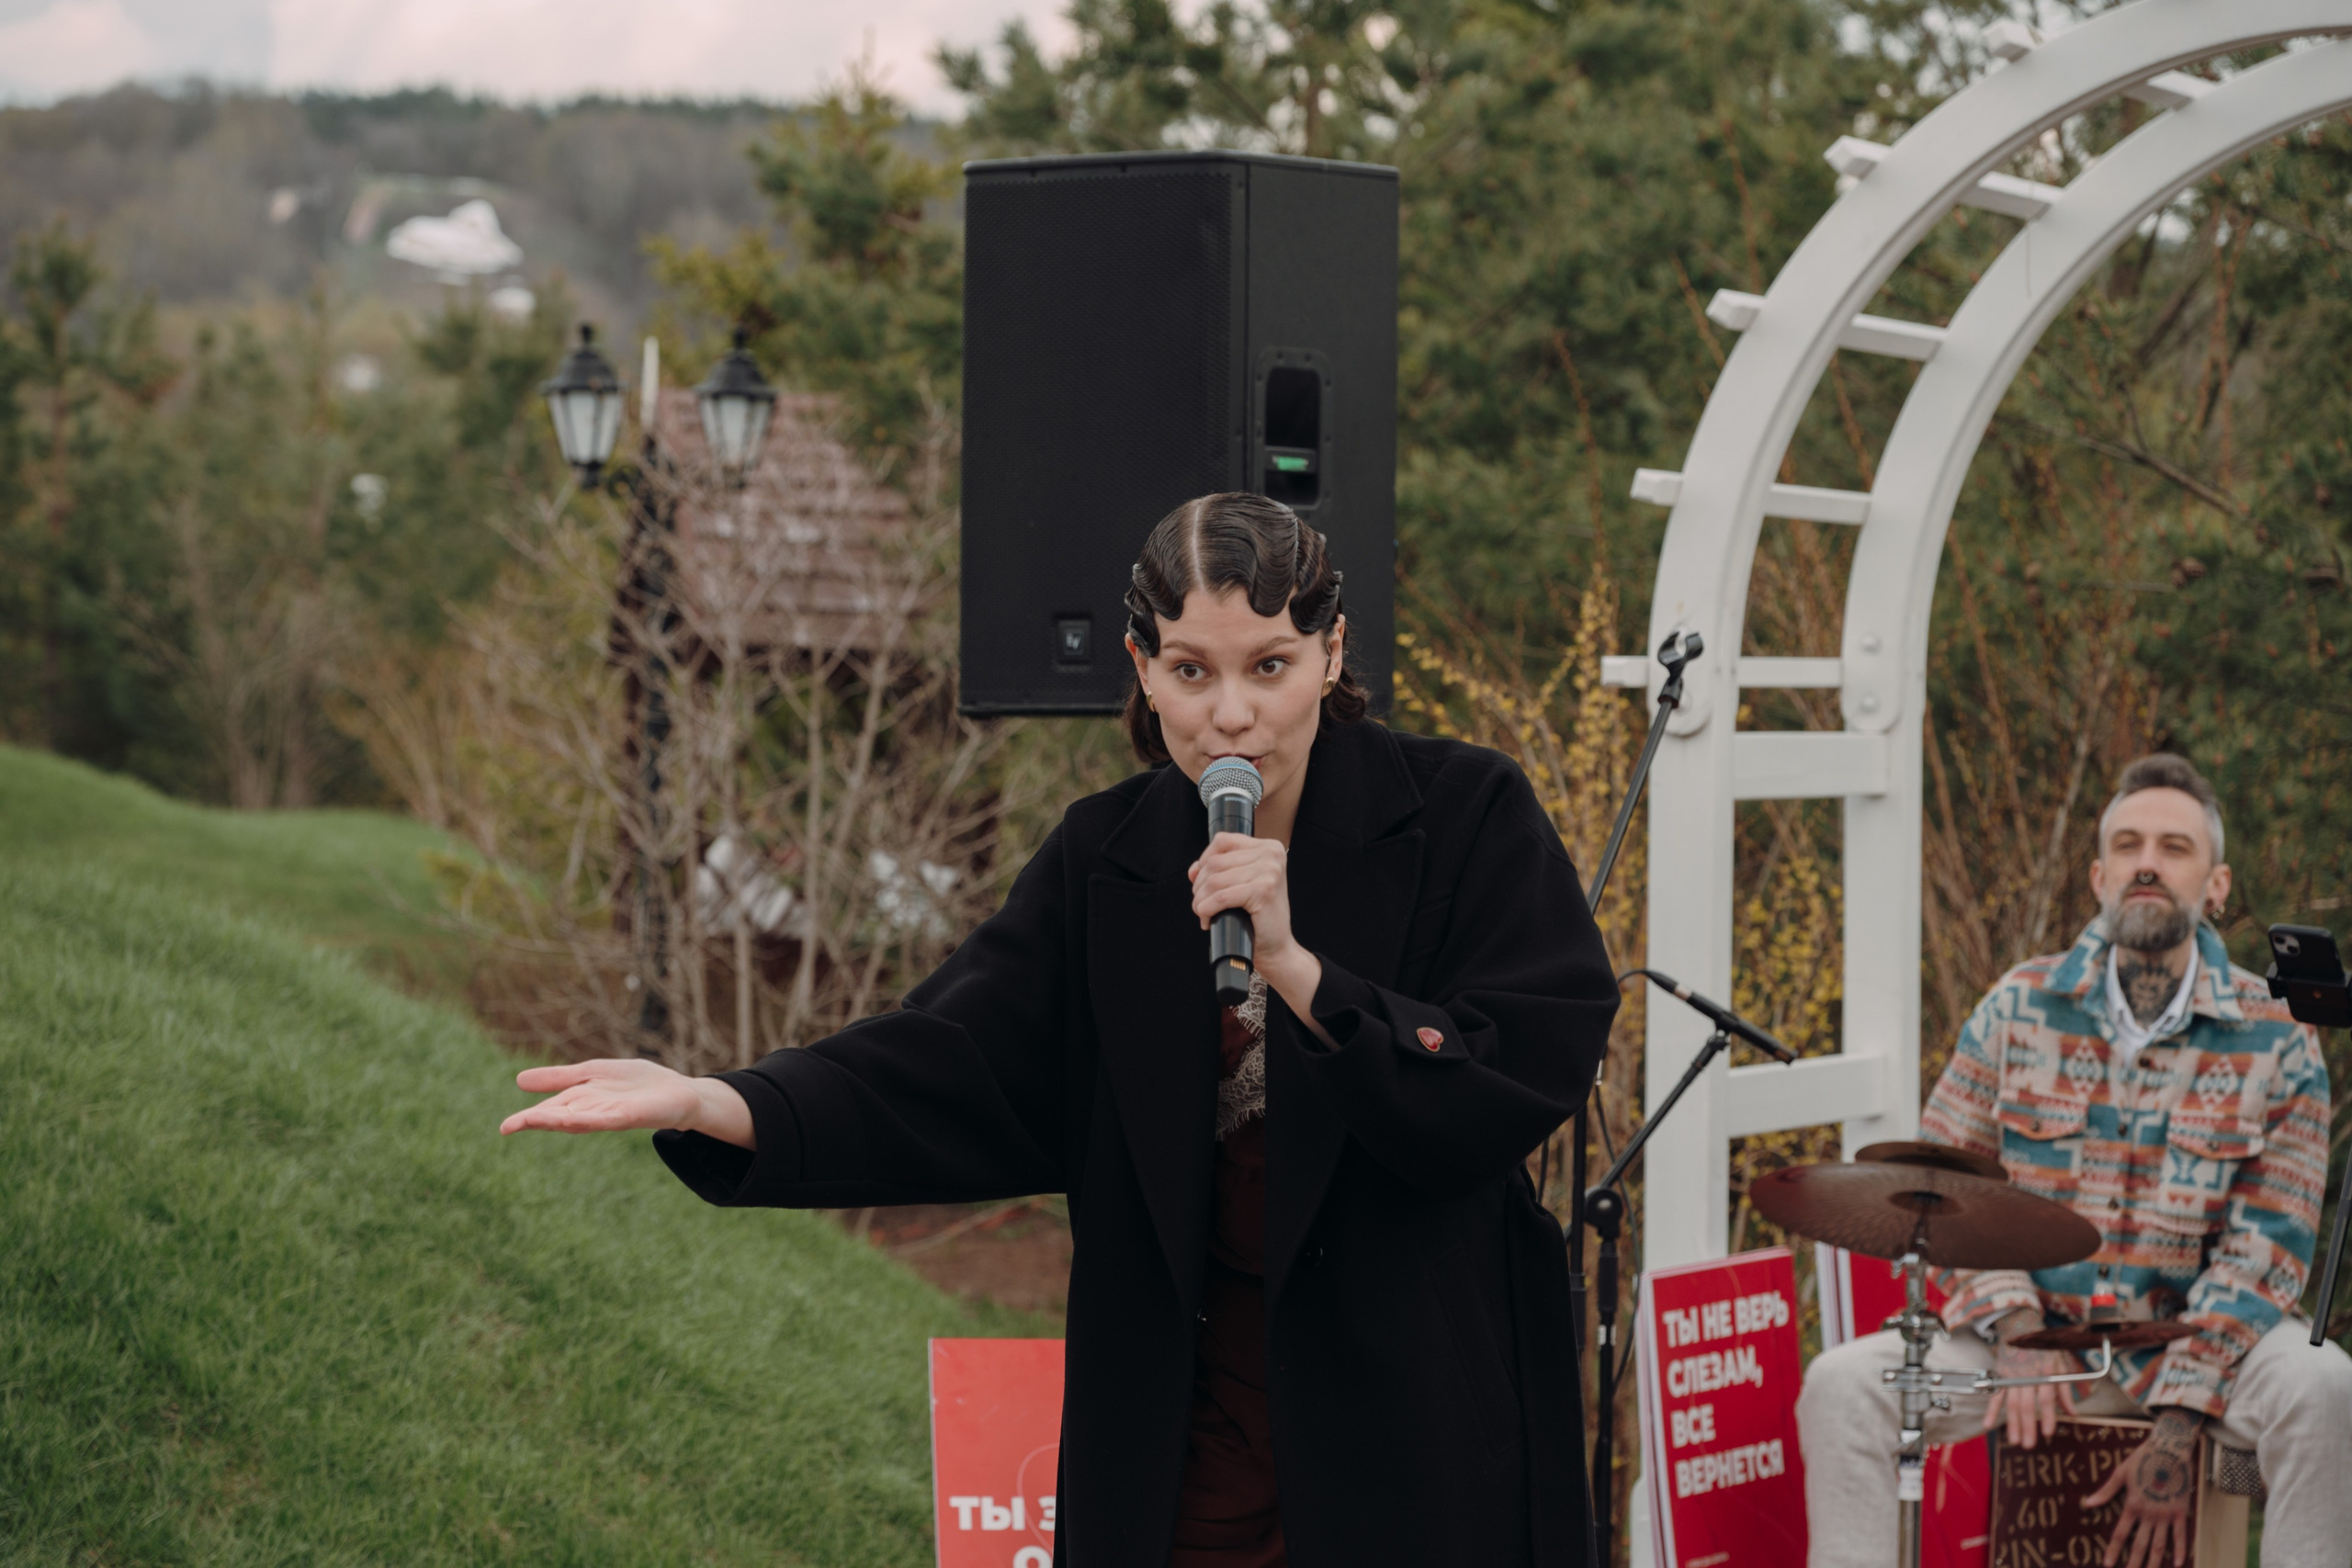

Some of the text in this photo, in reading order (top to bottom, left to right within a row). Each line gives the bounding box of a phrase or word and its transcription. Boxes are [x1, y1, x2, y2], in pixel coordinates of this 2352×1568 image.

[1662, 1290, 1790, 1348] ТЫ НЕ ВЕРЬ
[1667, 1344, 1764, 1398] СЛЕЗАМ,
[1670, 1403, 1715, 1449] ВСЕ
[1674, 1438, 1785, 1498] ВЕРНЕТСЯ
[948, 1495, 1026, 1531] ТЫ
